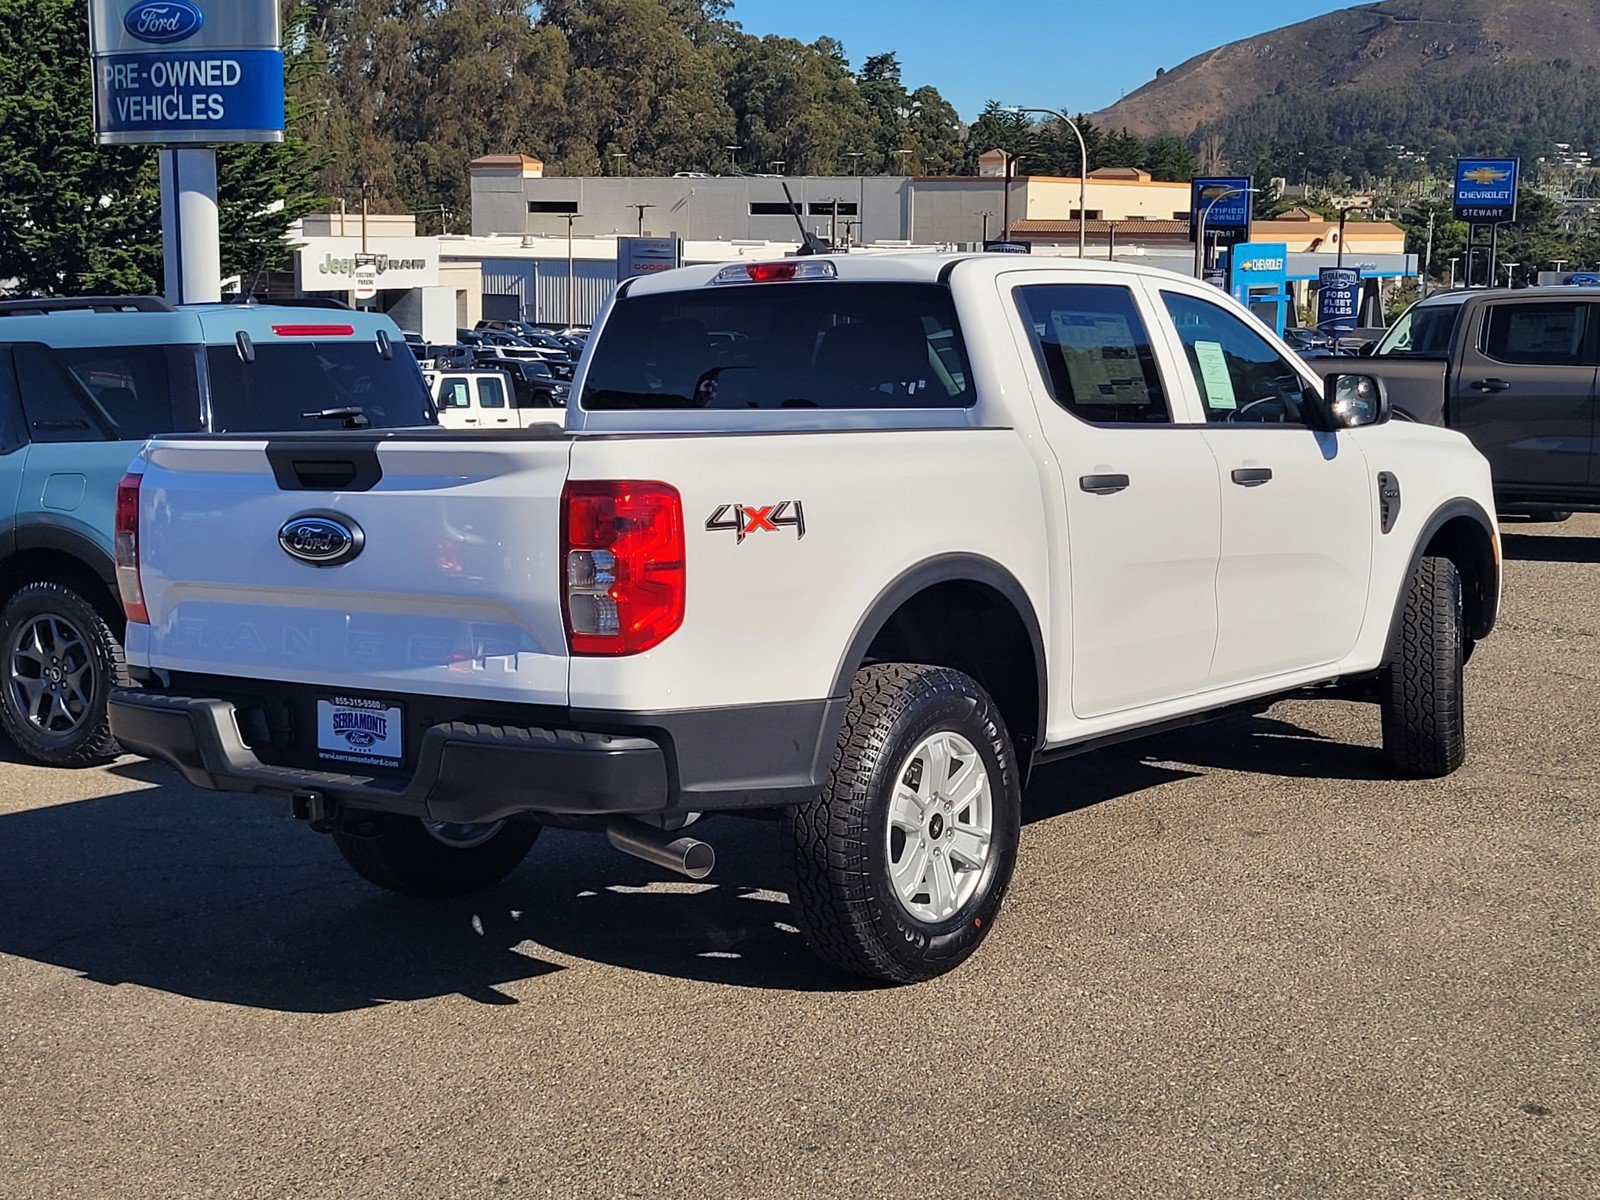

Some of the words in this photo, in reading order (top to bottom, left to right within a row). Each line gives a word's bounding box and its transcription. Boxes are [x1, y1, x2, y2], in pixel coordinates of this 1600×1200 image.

[137, 7, 181, 33] Ford
[103, 60, 241, 90] PRE-OWNED
[116, 94, 224, 122] VEHICLES
[1459, 191, 1509, 199] CHEVROLET
[1462, 209, 1503, 217] STEWART
[388, 259, 426, 270] RAM
[634, 263, 672, 271] DODGE
[1252, 258, 1284, 271] CHEVROLET
[1325, 291, 1351, 299] FORD
[1324, 299, 1352, 307] FLEET
[1323, 307, 1352, 315] SALES
[293, 527, 333, 551] Ford
[174, 616, 523, 674] RANGER
[335, 697, 380, 709] 855-315-9580
[332, 712, 387, 736] SERRAMONTE
[350, 731, 370, 744] Ford
[318, 752, 399, 768] www.serramonteford.com
